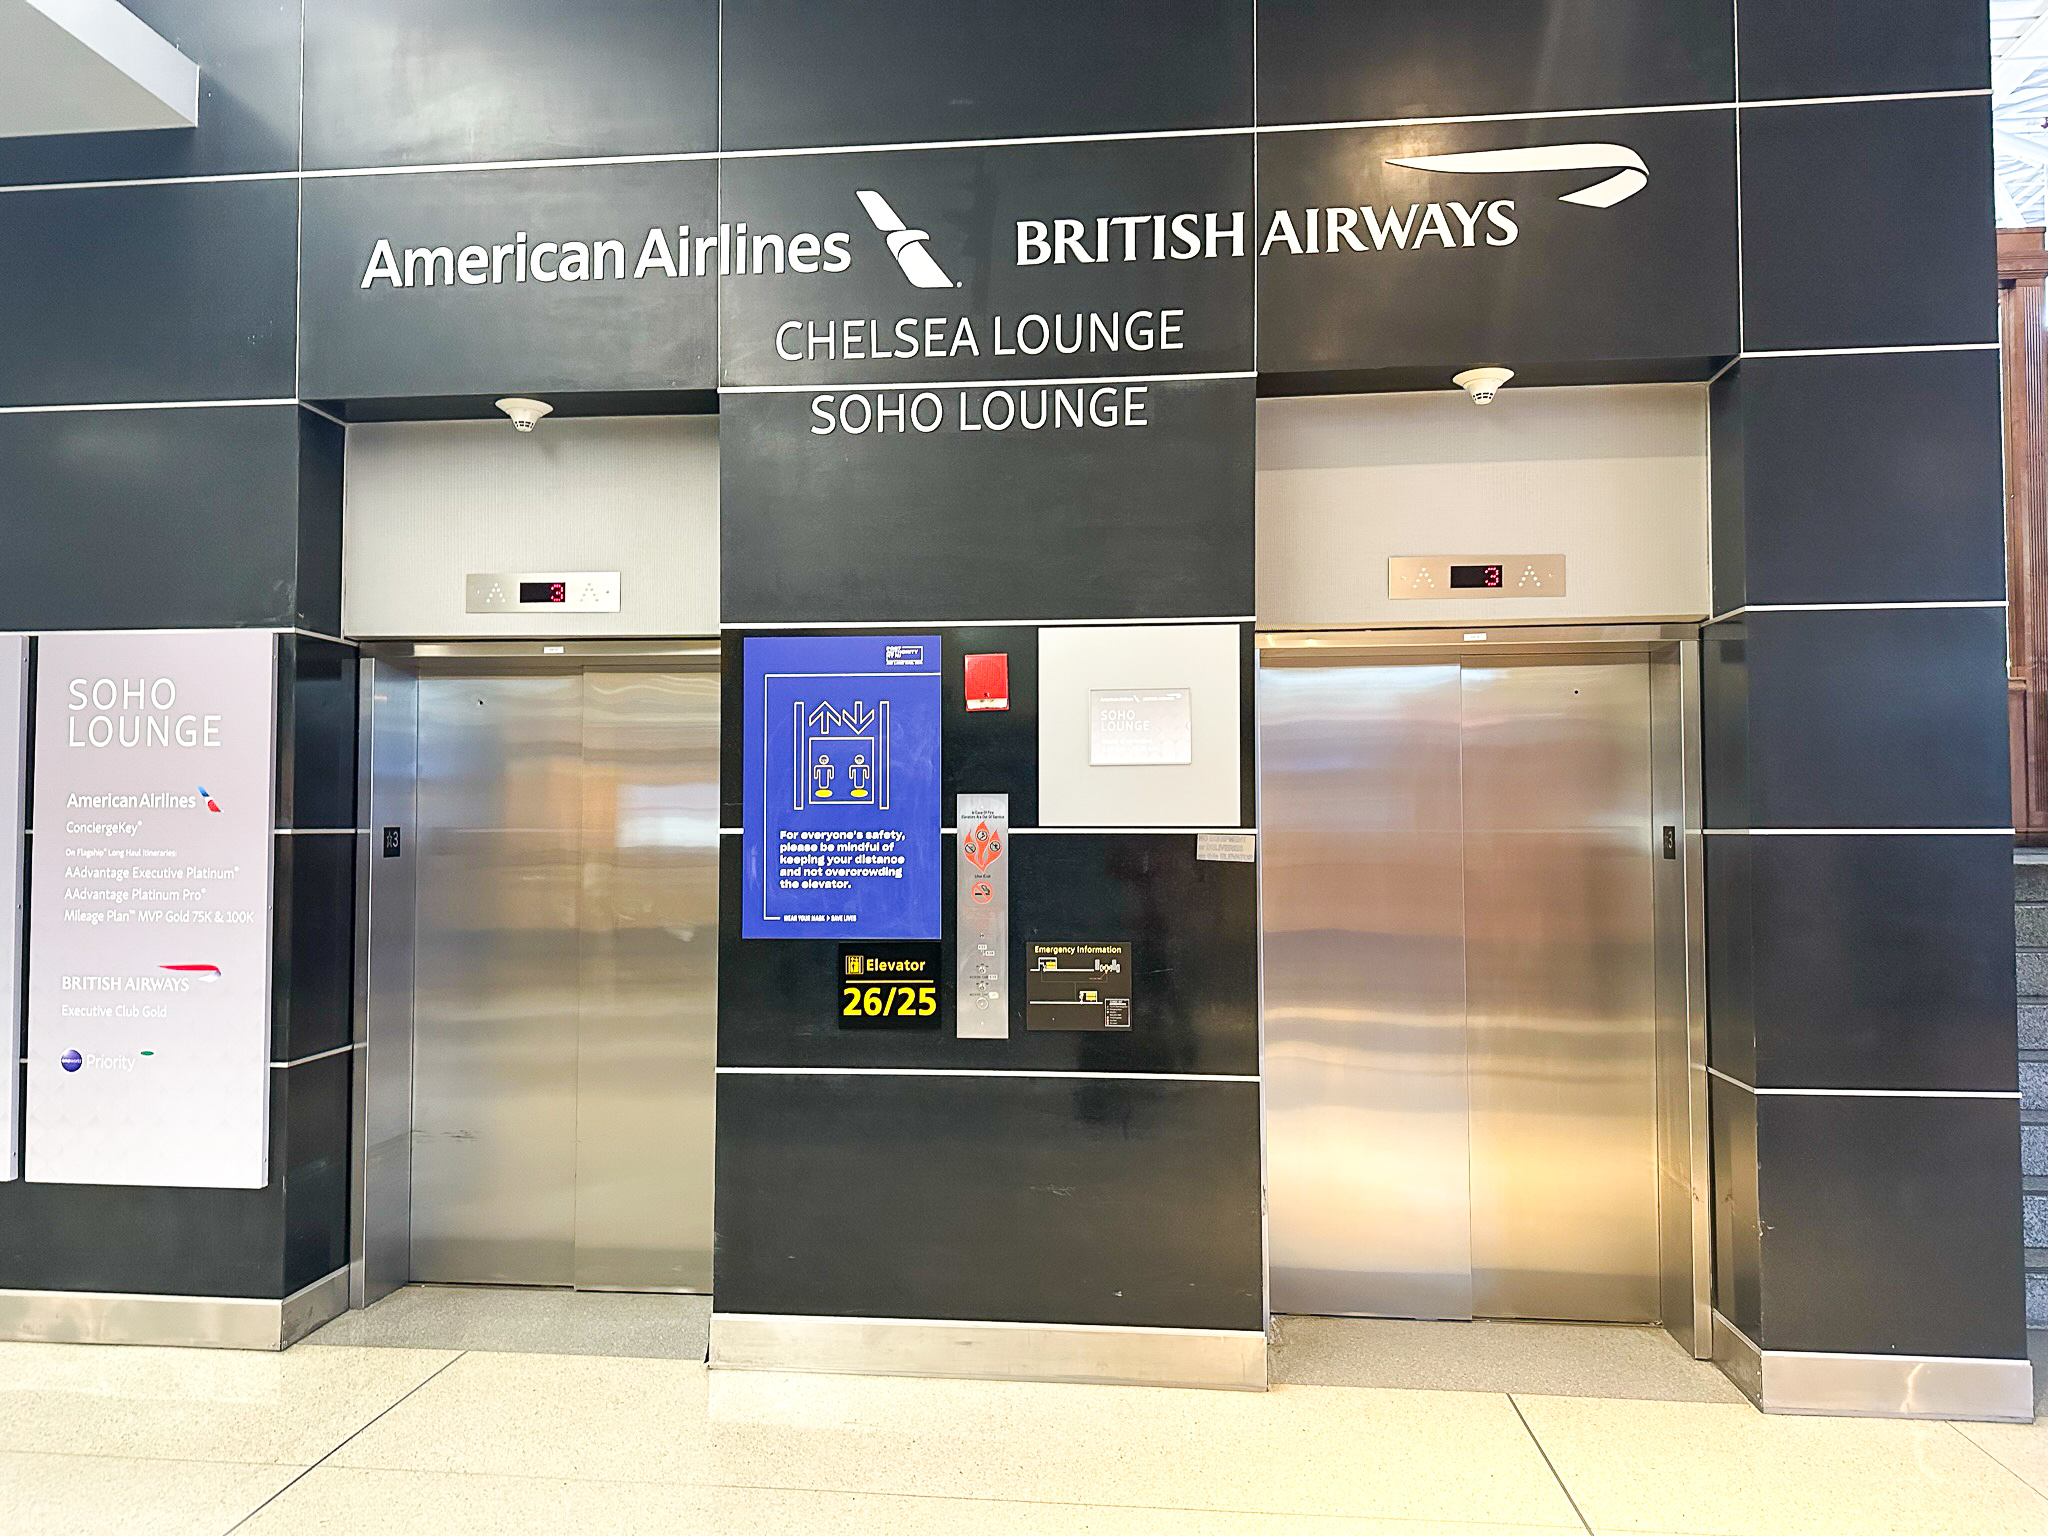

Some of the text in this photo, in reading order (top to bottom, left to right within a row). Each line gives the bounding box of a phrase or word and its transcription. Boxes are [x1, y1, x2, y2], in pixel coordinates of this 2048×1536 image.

[1016, 200, 1519, 266] BRITISH AIRWAYS
[361, 223, 852, 289] American Airlines
[775, 309, 1184, 361] CHELSEA LOUNGE
[811, 386, 1148, 435] SOHO LOUNGE
[1485, 567, 1499, 587] 3
[551, 584, 564, 602] 3
[68, 678, 176, 711] SOHO
[1100, 709, 1135, 721] SOHO
[69, 715, 221, 747] LOUNGE
[1101, 720, 1150, 731] LOUNGE
[67, 792, 196, 808] American Airlines
[393, 831, 399, 847] 3
[780, 830, 905, 841] For everyone's safety,
[65, 849, 75, 857] On
[108, 849, 124, 858] Long
[126, 849, 141, 857] Haul
[142, 849, 177, 858] Itineraries:
[780, 842, 894, 854] please be mindful of
[780, 854, 905, 866] keeping your distance
[65, 866, 129, 881] AAdvantage
[133, 866, 183, 879] Executive
[780, 867, 903, 878] and not overcrowding
[780, 879, 852, 889] the elevator.
[64, 888, 129, 904] AAdvantage
[132, 888, 179, 901] Platinum
[64, 909, 104, 925] Mileage
[138, 910, 163, 923] MVP
[165, 910, 190, 923] Gold
[192, 911, 212, 923] 75K
[214, 911, 224, 923] &
[226, 911, 255, 923] 100K
[1034, 945, 1122, 955] Emergency Information
[866, 957, 926, 972] Elevator
[61, 976, 190, 992] BRITISH AIRWAYS
[843, 986, 937, 1016] 26/25
[61, 1004, 167, 1018] Executive Club Gold
[87, 1054, 136, 1072] Priority
